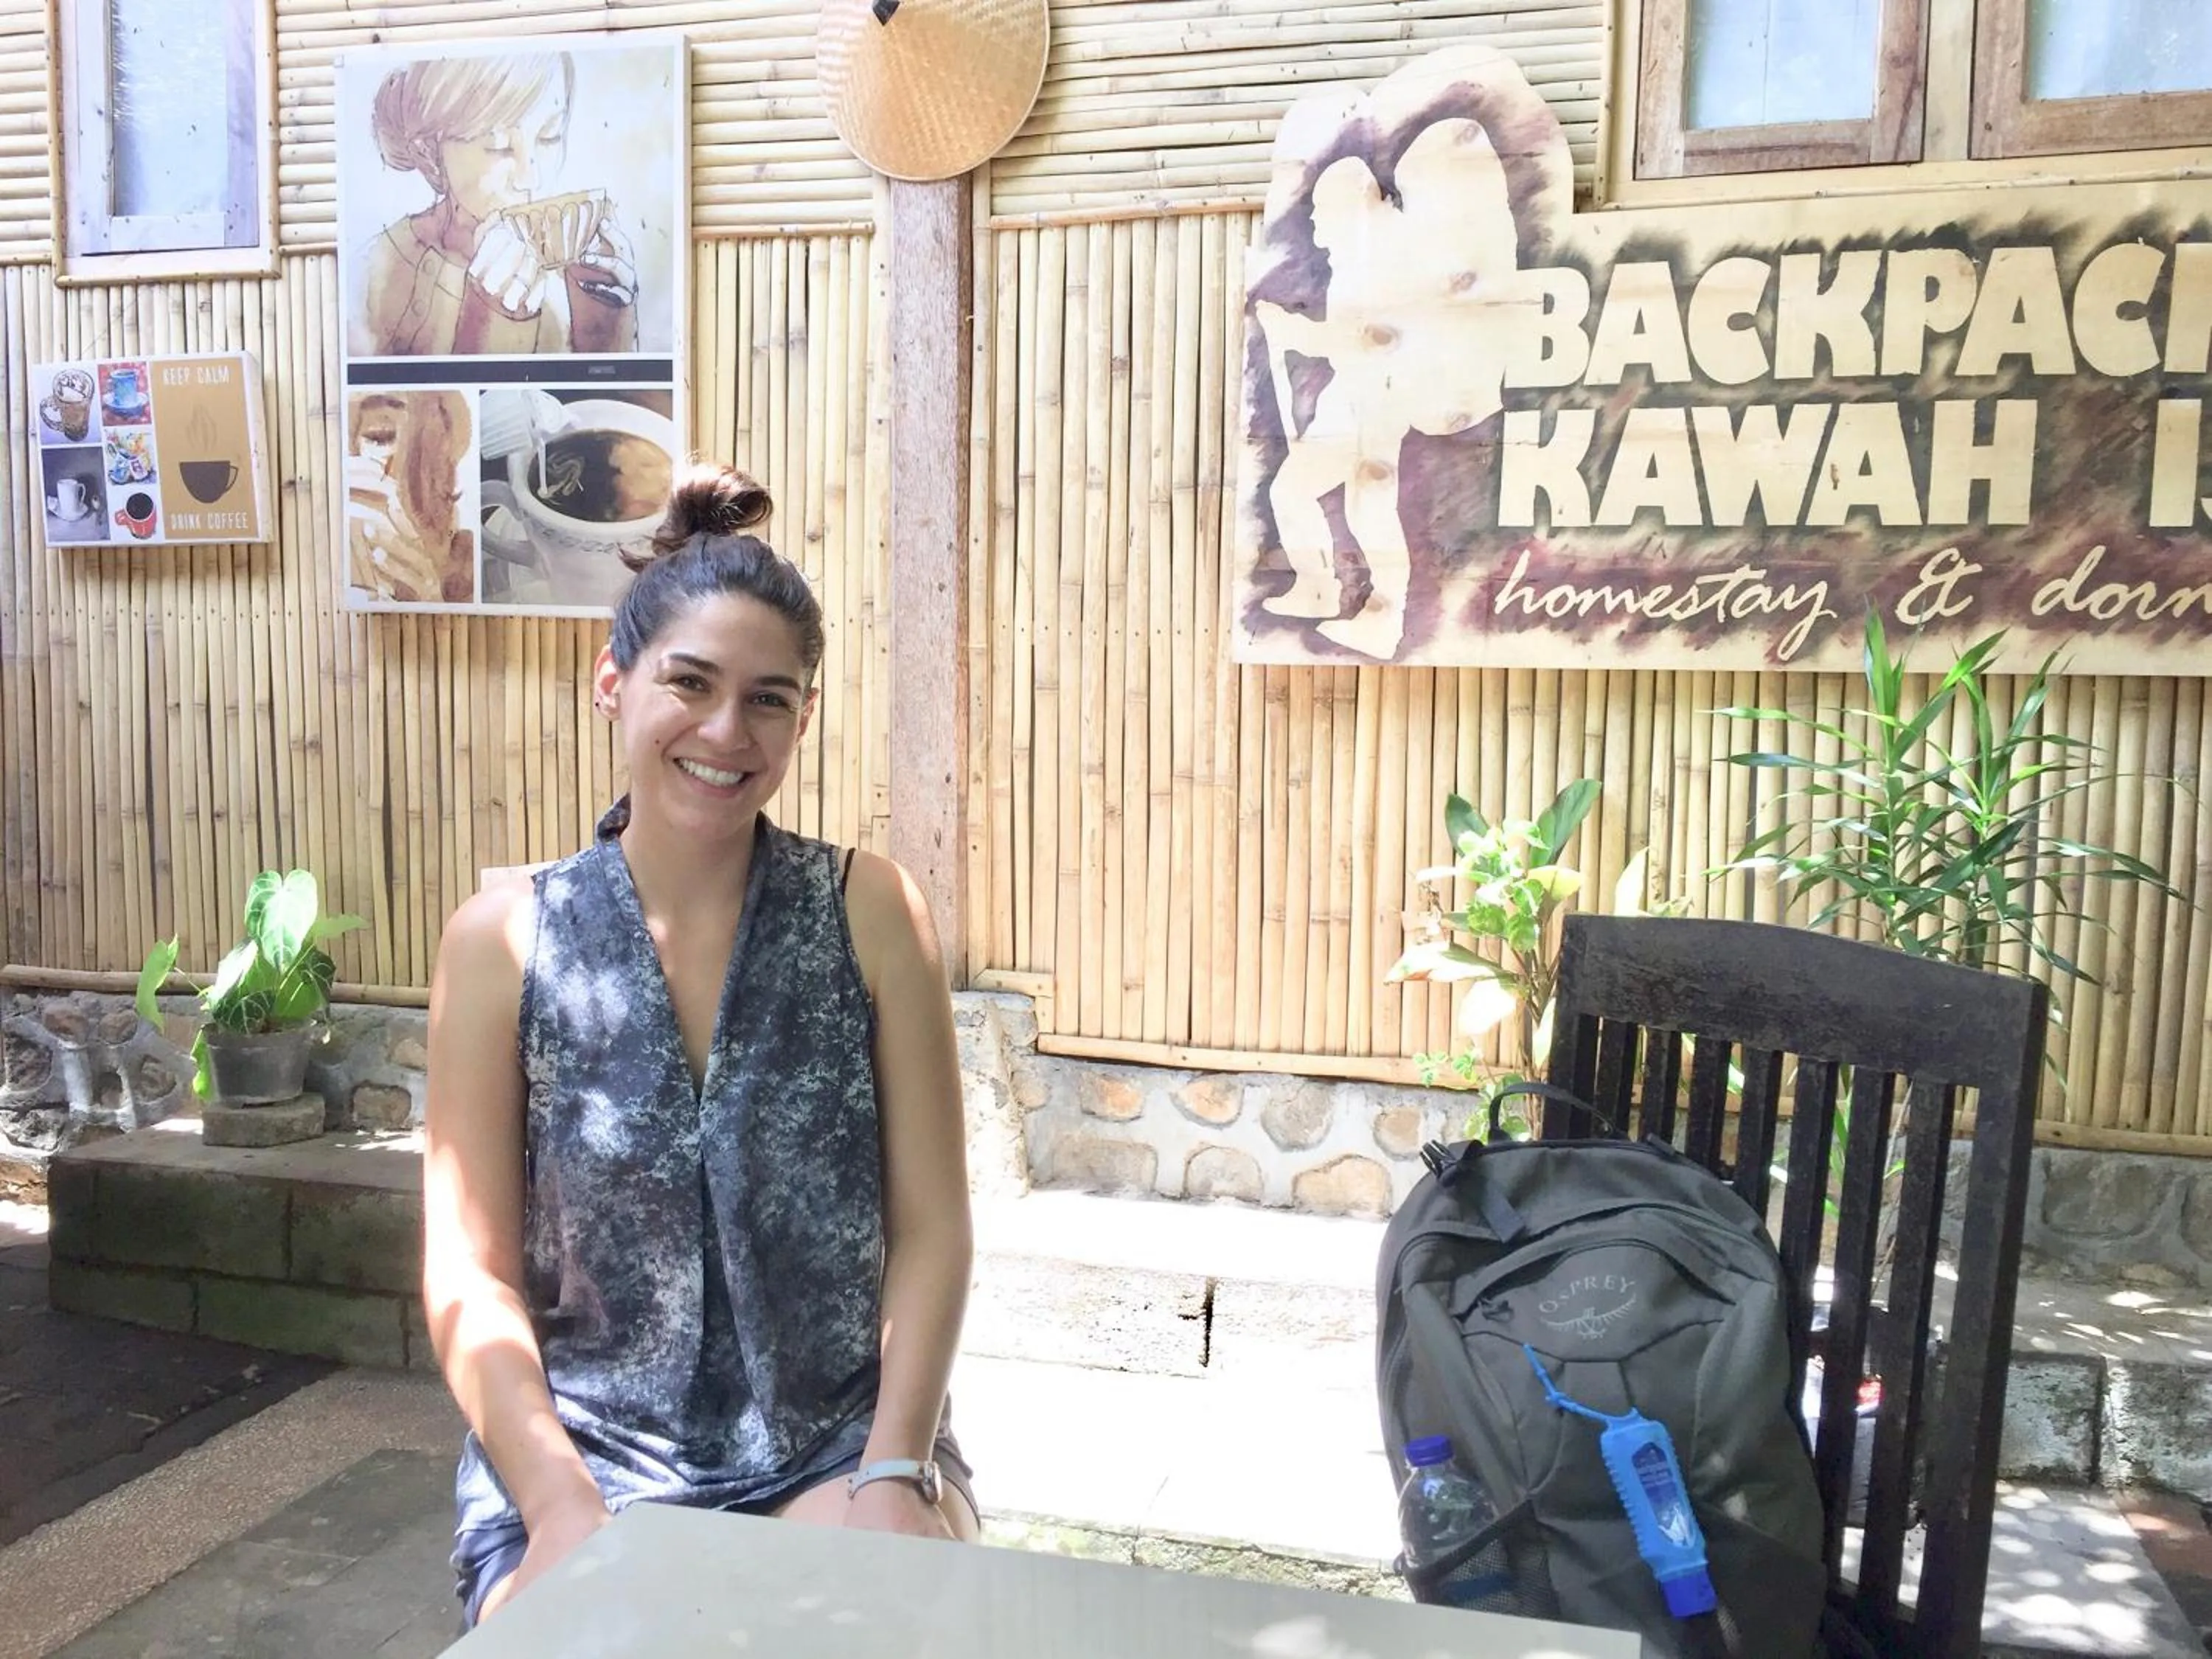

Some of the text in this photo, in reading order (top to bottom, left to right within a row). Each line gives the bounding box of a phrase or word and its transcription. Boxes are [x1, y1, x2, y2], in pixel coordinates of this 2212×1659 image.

[163, 365, 229, 385] KEEP CALM
[1498, 399, 2212, 527] KAWAH I
[170, 512, 248, 531] DRINK COFFEE
[1494, 550, 1837, 661] homestay
[1896, 547, 1982, 625] &
